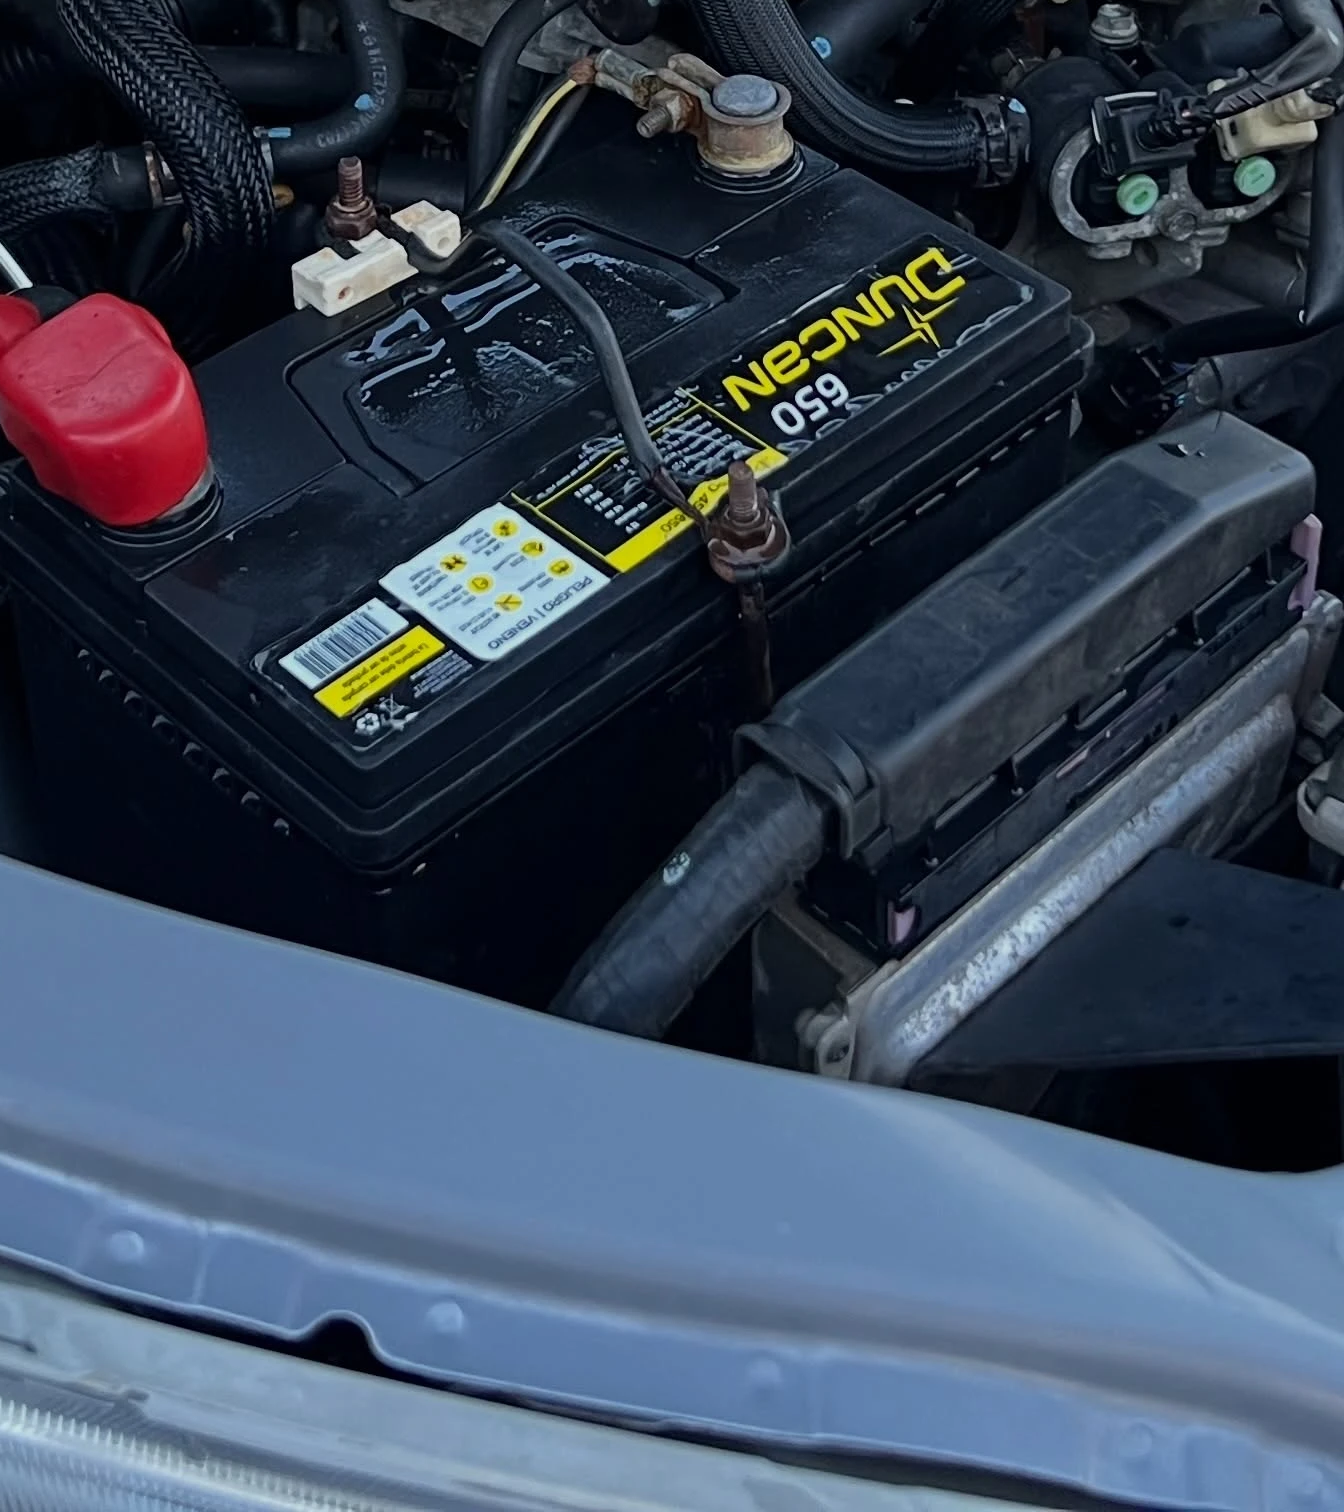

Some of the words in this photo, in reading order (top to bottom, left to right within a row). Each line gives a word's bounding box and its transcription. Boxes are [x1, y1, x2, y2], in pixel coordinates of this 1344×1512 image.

[771, 373, 849, 436] 650
[542, 575, 594, 612] PELIGRO
[487, 613, 537, 650] VENENO
